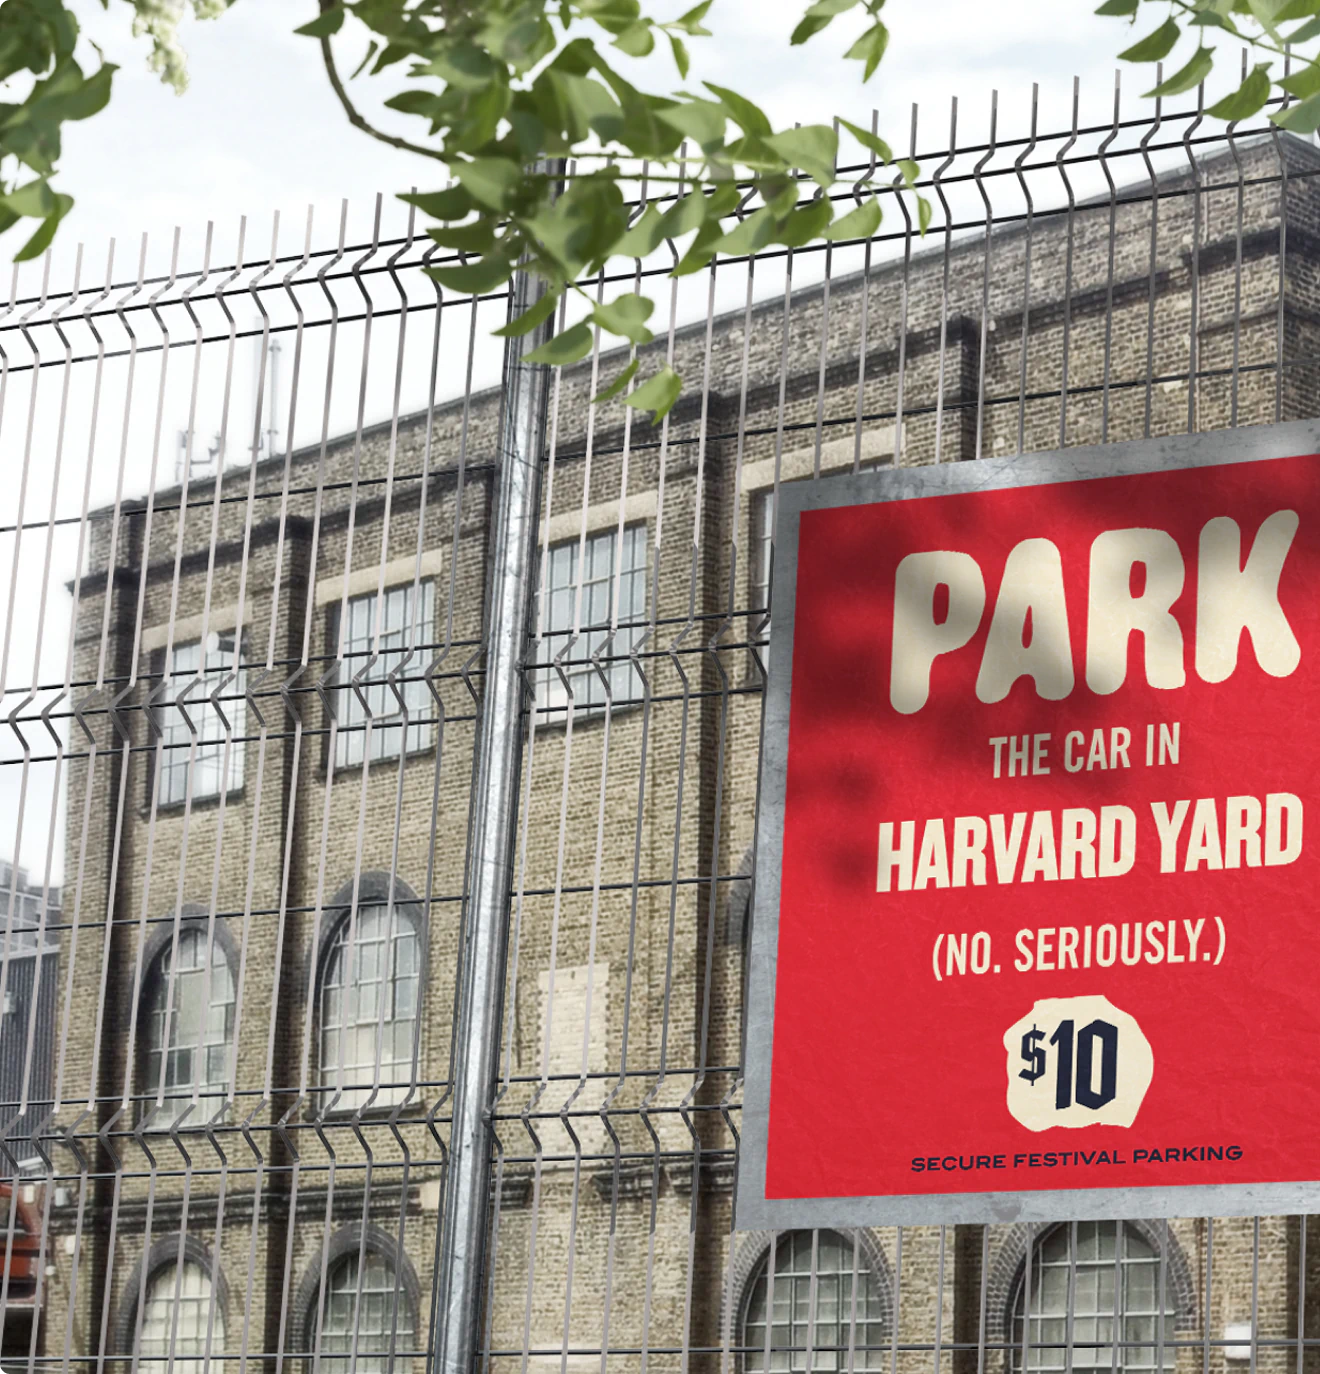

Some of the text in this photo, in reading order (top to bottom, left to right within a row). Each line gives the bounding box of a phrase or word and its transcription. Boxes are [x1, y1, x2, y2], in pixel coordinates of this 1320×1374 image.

[888, 508, 1302, 715] PARK
[988, 721, 1181, 779] THE CAR IN
[875, 791, 1304, 893] HARVARD YARD
[932, 916, 1226, 981] (NO. SERIOUSLY.)
[1018, 1018, 1118, 1110] $10
[910, 1145, 1243, 1173] SECURE FESTIVAL PARKING
